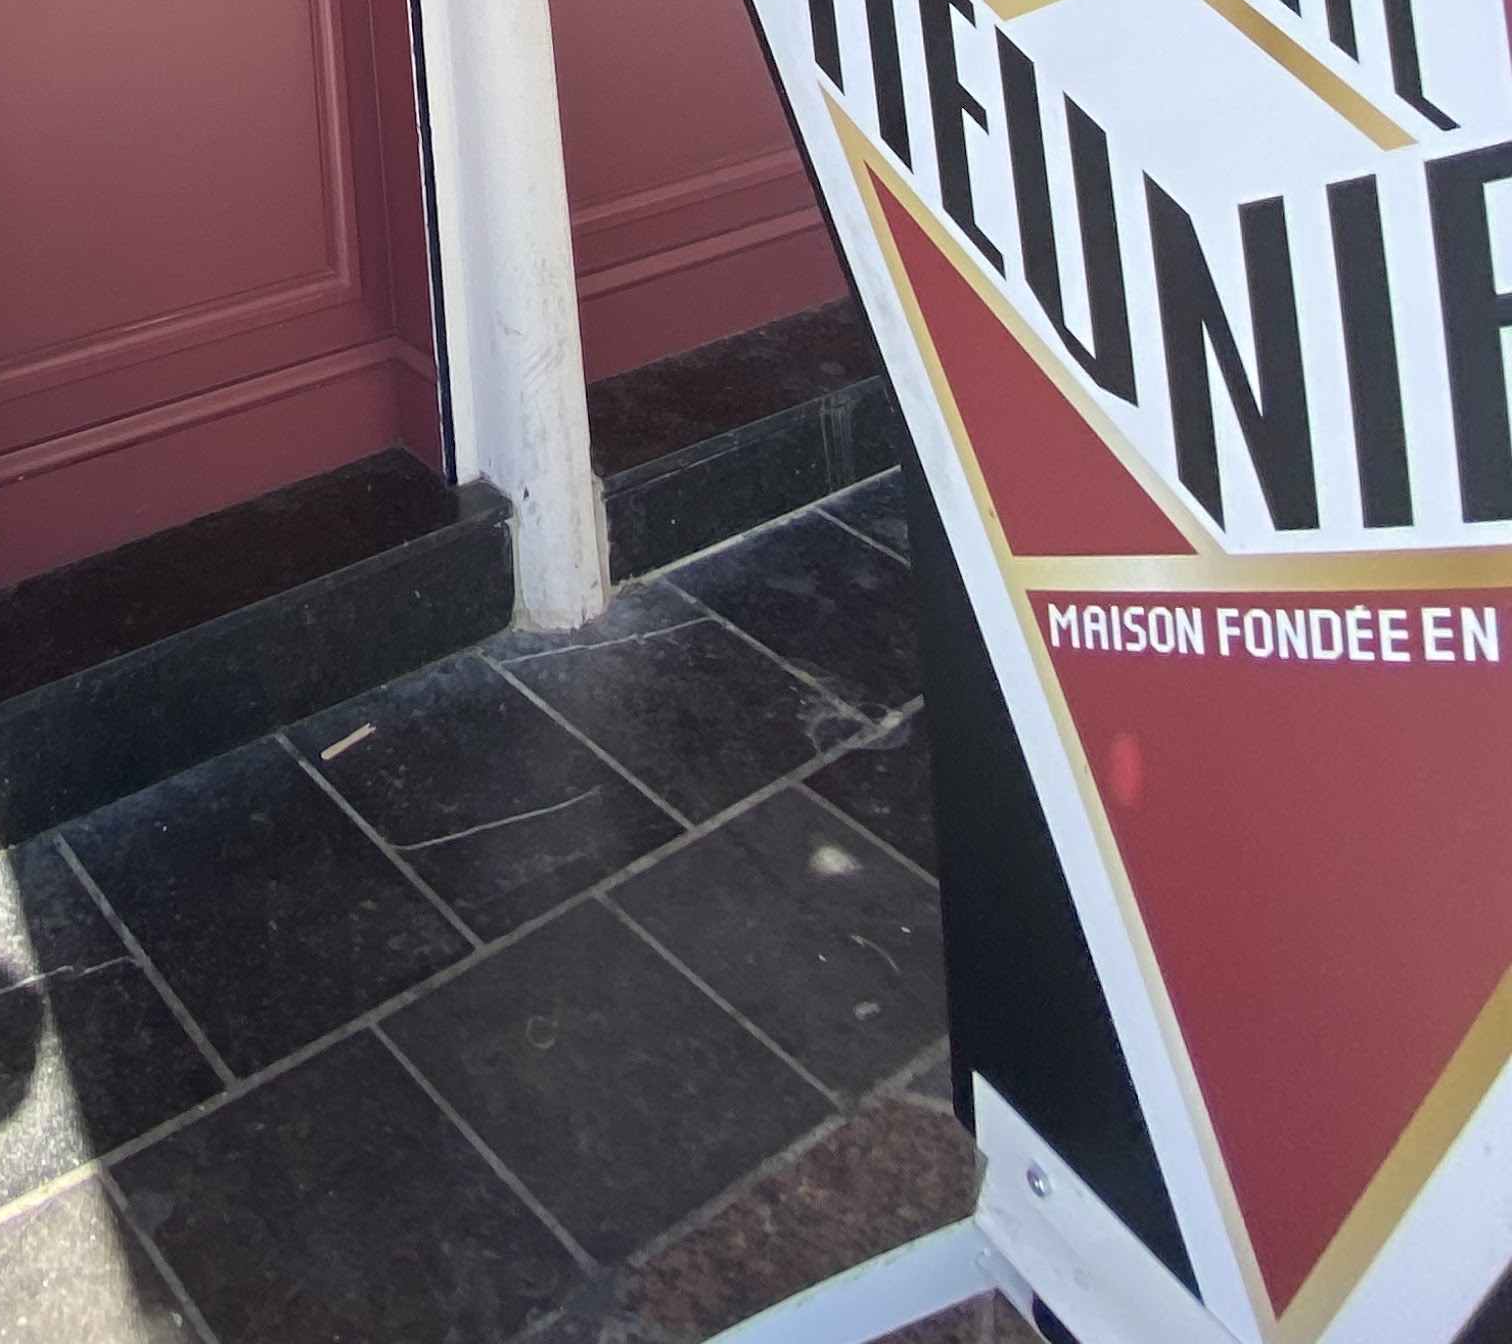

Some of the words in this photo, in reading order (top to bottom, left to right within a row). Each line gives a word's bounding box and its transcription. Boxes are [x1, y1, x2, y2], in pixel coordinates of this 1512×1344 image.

[1047, 603, 1205, 656] MAISON
[1216, 605, 1411, 662] FONDÉE
[1421, 606, 1500, 662] EN
